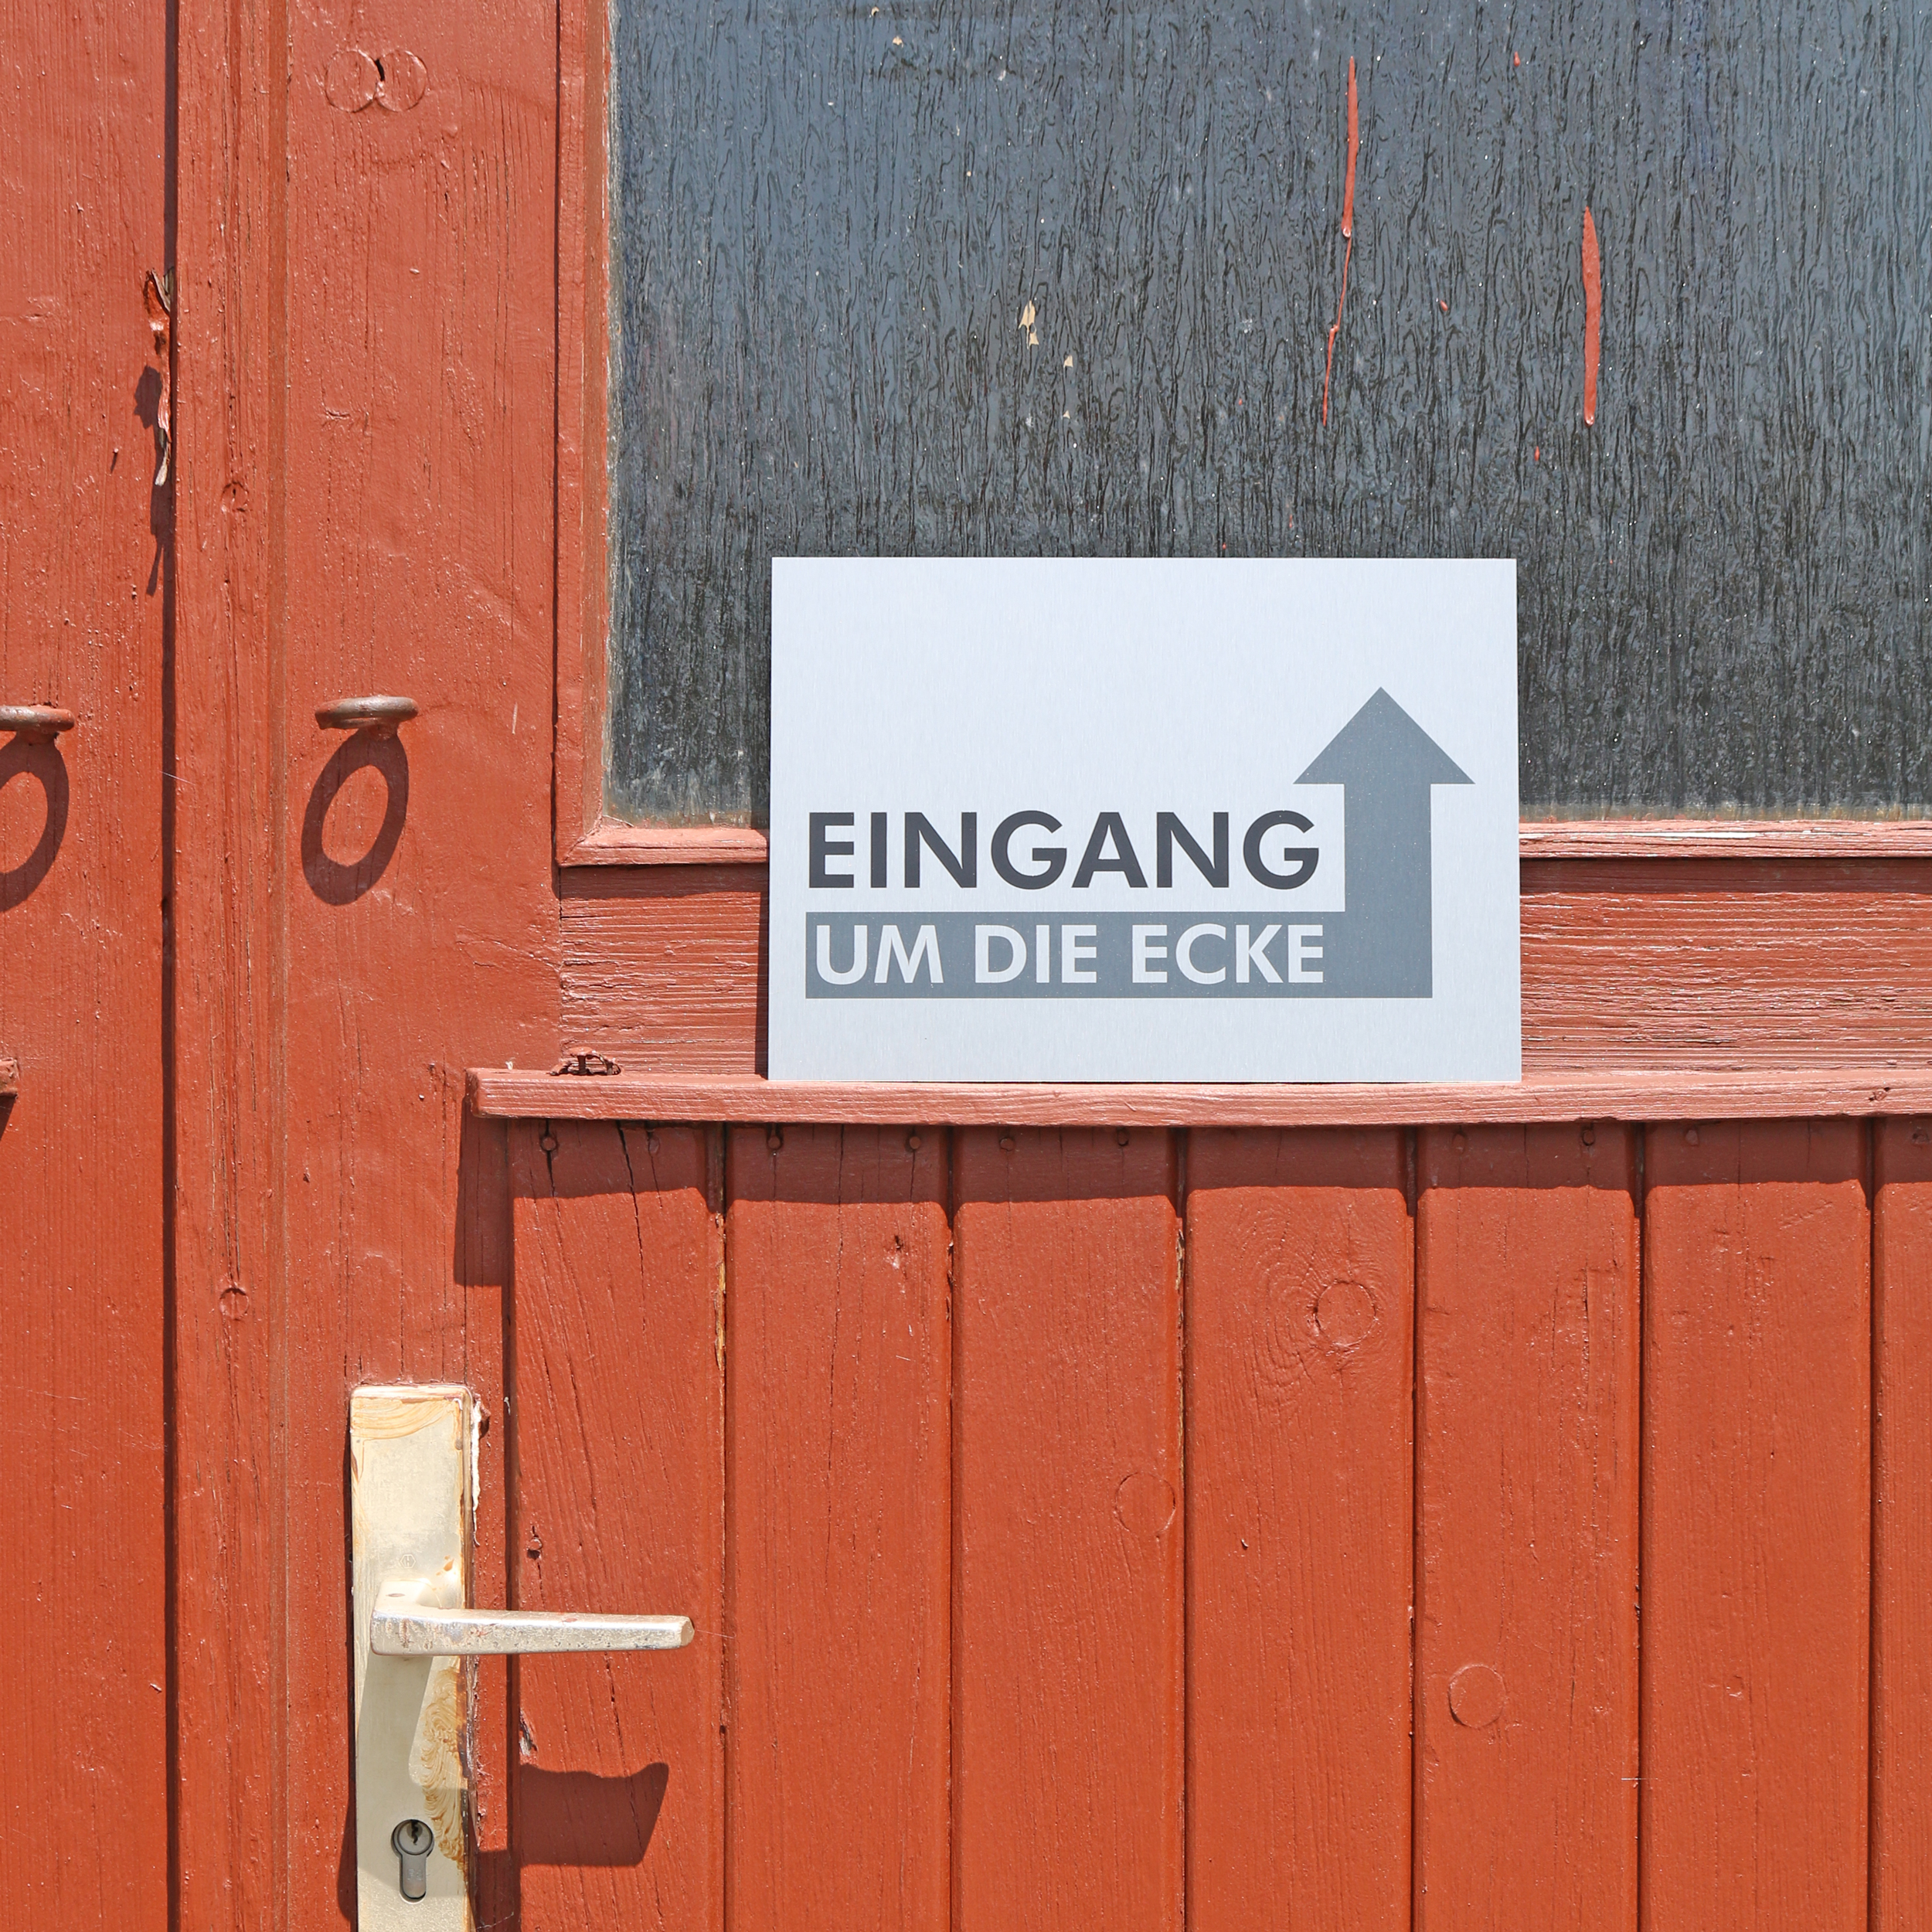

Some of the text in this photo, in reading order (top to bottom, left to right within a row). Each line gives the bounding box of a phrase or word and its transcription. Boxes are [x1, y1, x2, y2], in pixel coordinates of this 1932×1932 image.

[808, 810, 1319, 890] EINGANG
[816, 923, 1324, 985] UM DIE ECKE
